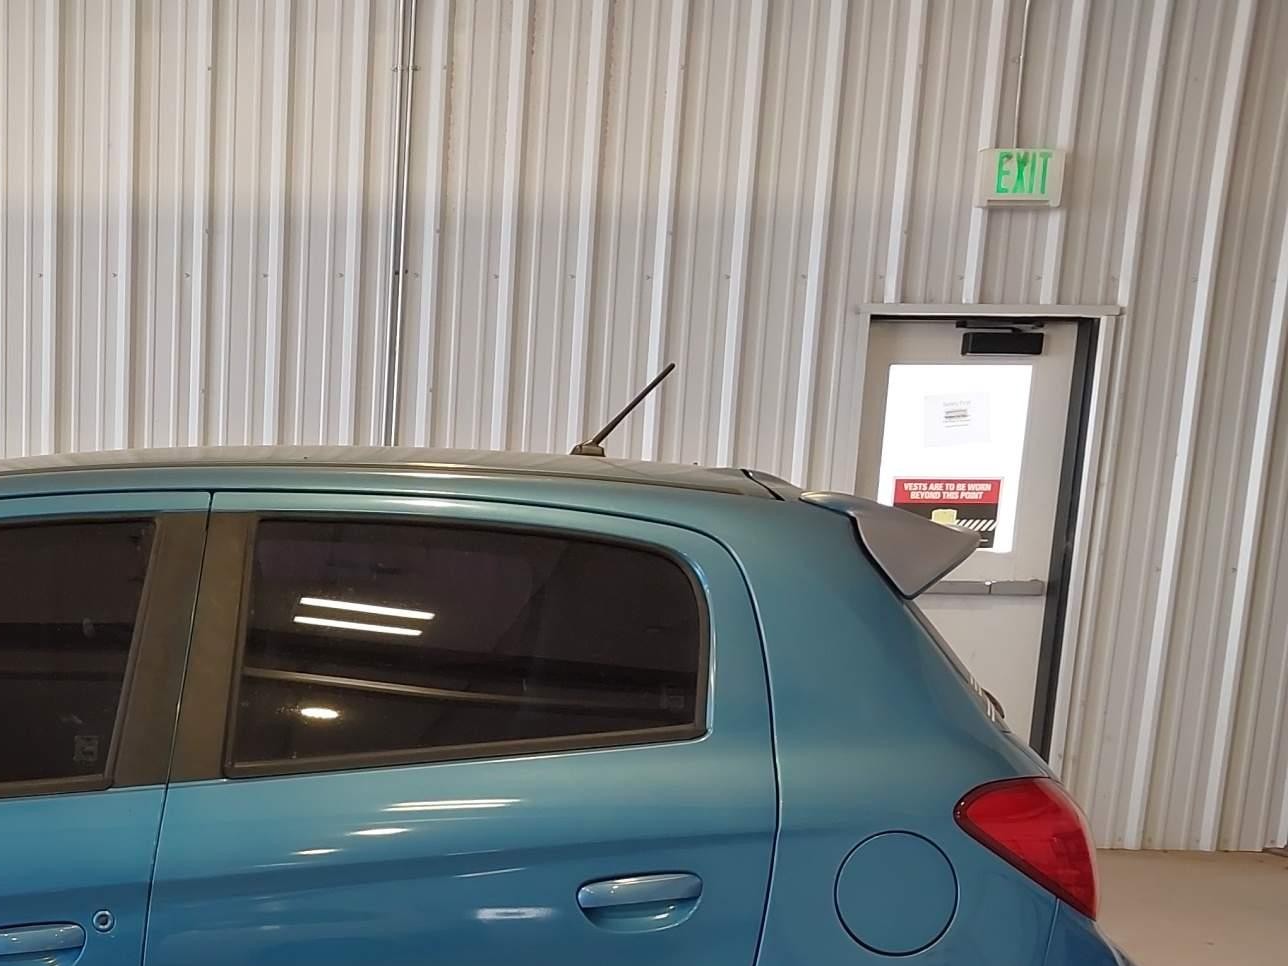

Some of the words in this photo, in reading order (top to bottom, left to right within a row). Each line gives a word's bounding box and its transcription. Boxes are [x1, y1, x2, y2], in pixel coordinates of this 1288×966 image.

[996, 151, 1052, 194] EXIT
[903, 482, 928, 491] VESTS
[928, 482, 944, 491] ARE
[945, 482, 955, 491] TO
[956, 482, 967, 491] BE
[967, 482, 992, 492] WORN
[910, 491, 941, 499] BEYOND
[942, 491, 959, 499] THIS
[959, 491, 984, 499] POINT
